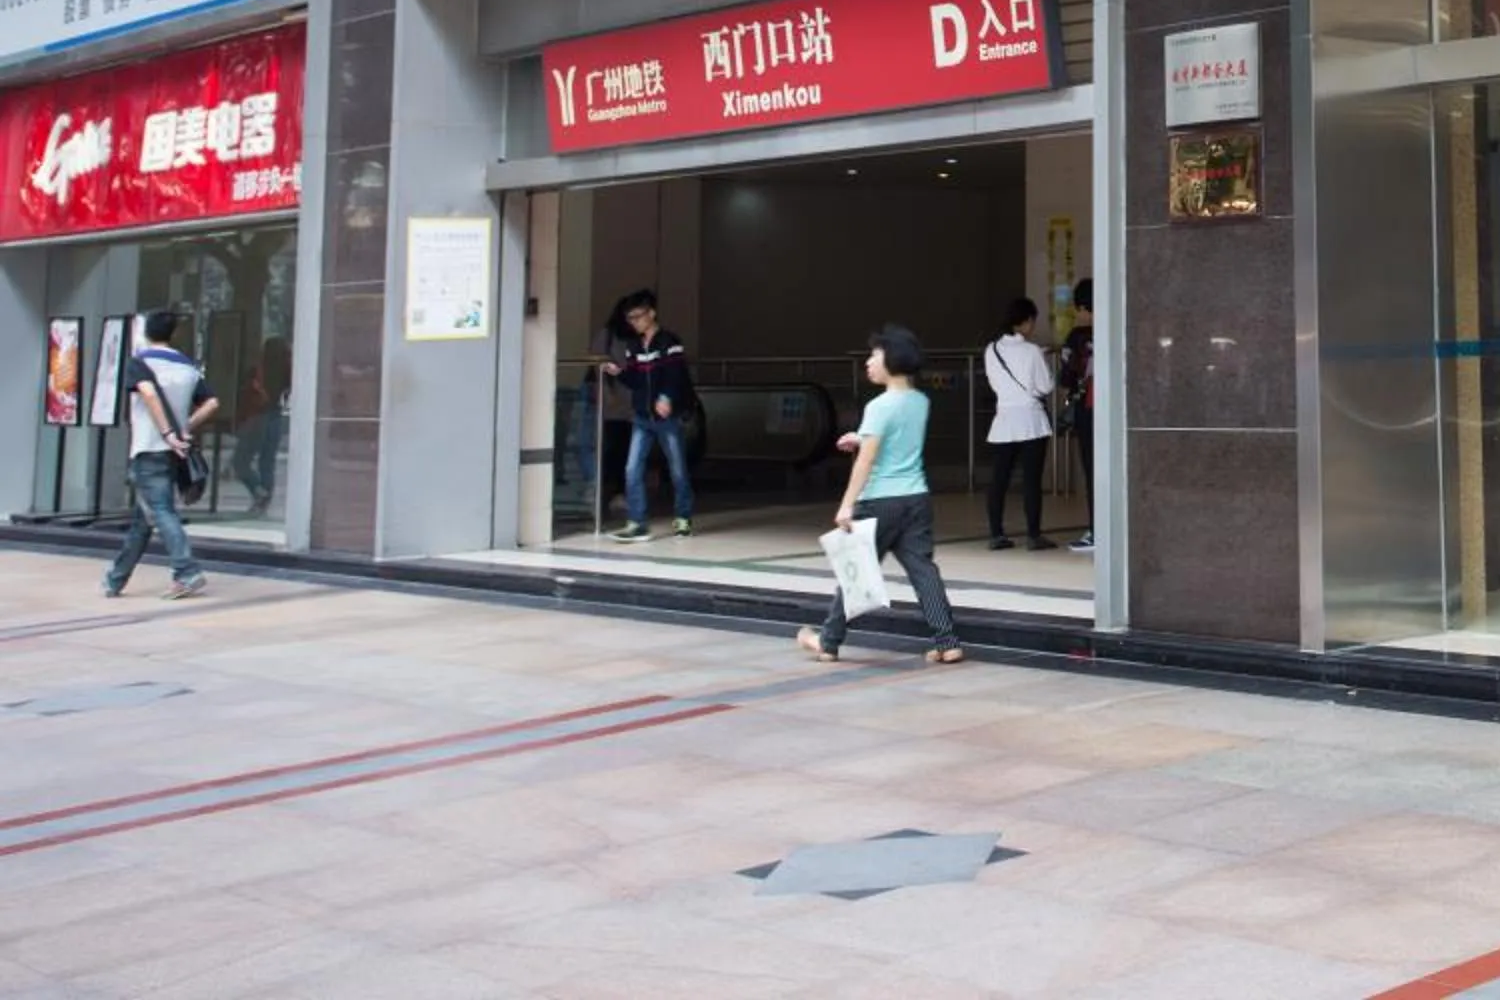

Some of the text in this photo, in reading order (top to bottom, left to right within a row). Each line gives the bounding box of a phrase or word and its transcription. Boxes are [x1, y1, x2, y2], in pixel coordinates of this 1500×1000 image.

[700, 7, 834, 82] 西门口站
[930, 3, 968, 68] D
[979, 40, 1038, 61] Entrance
[586, 59, 666, 105] 广州地铁
[722, 83, 822, 118] Ximenkou
[140, 92, 278, 173] 国美电器
